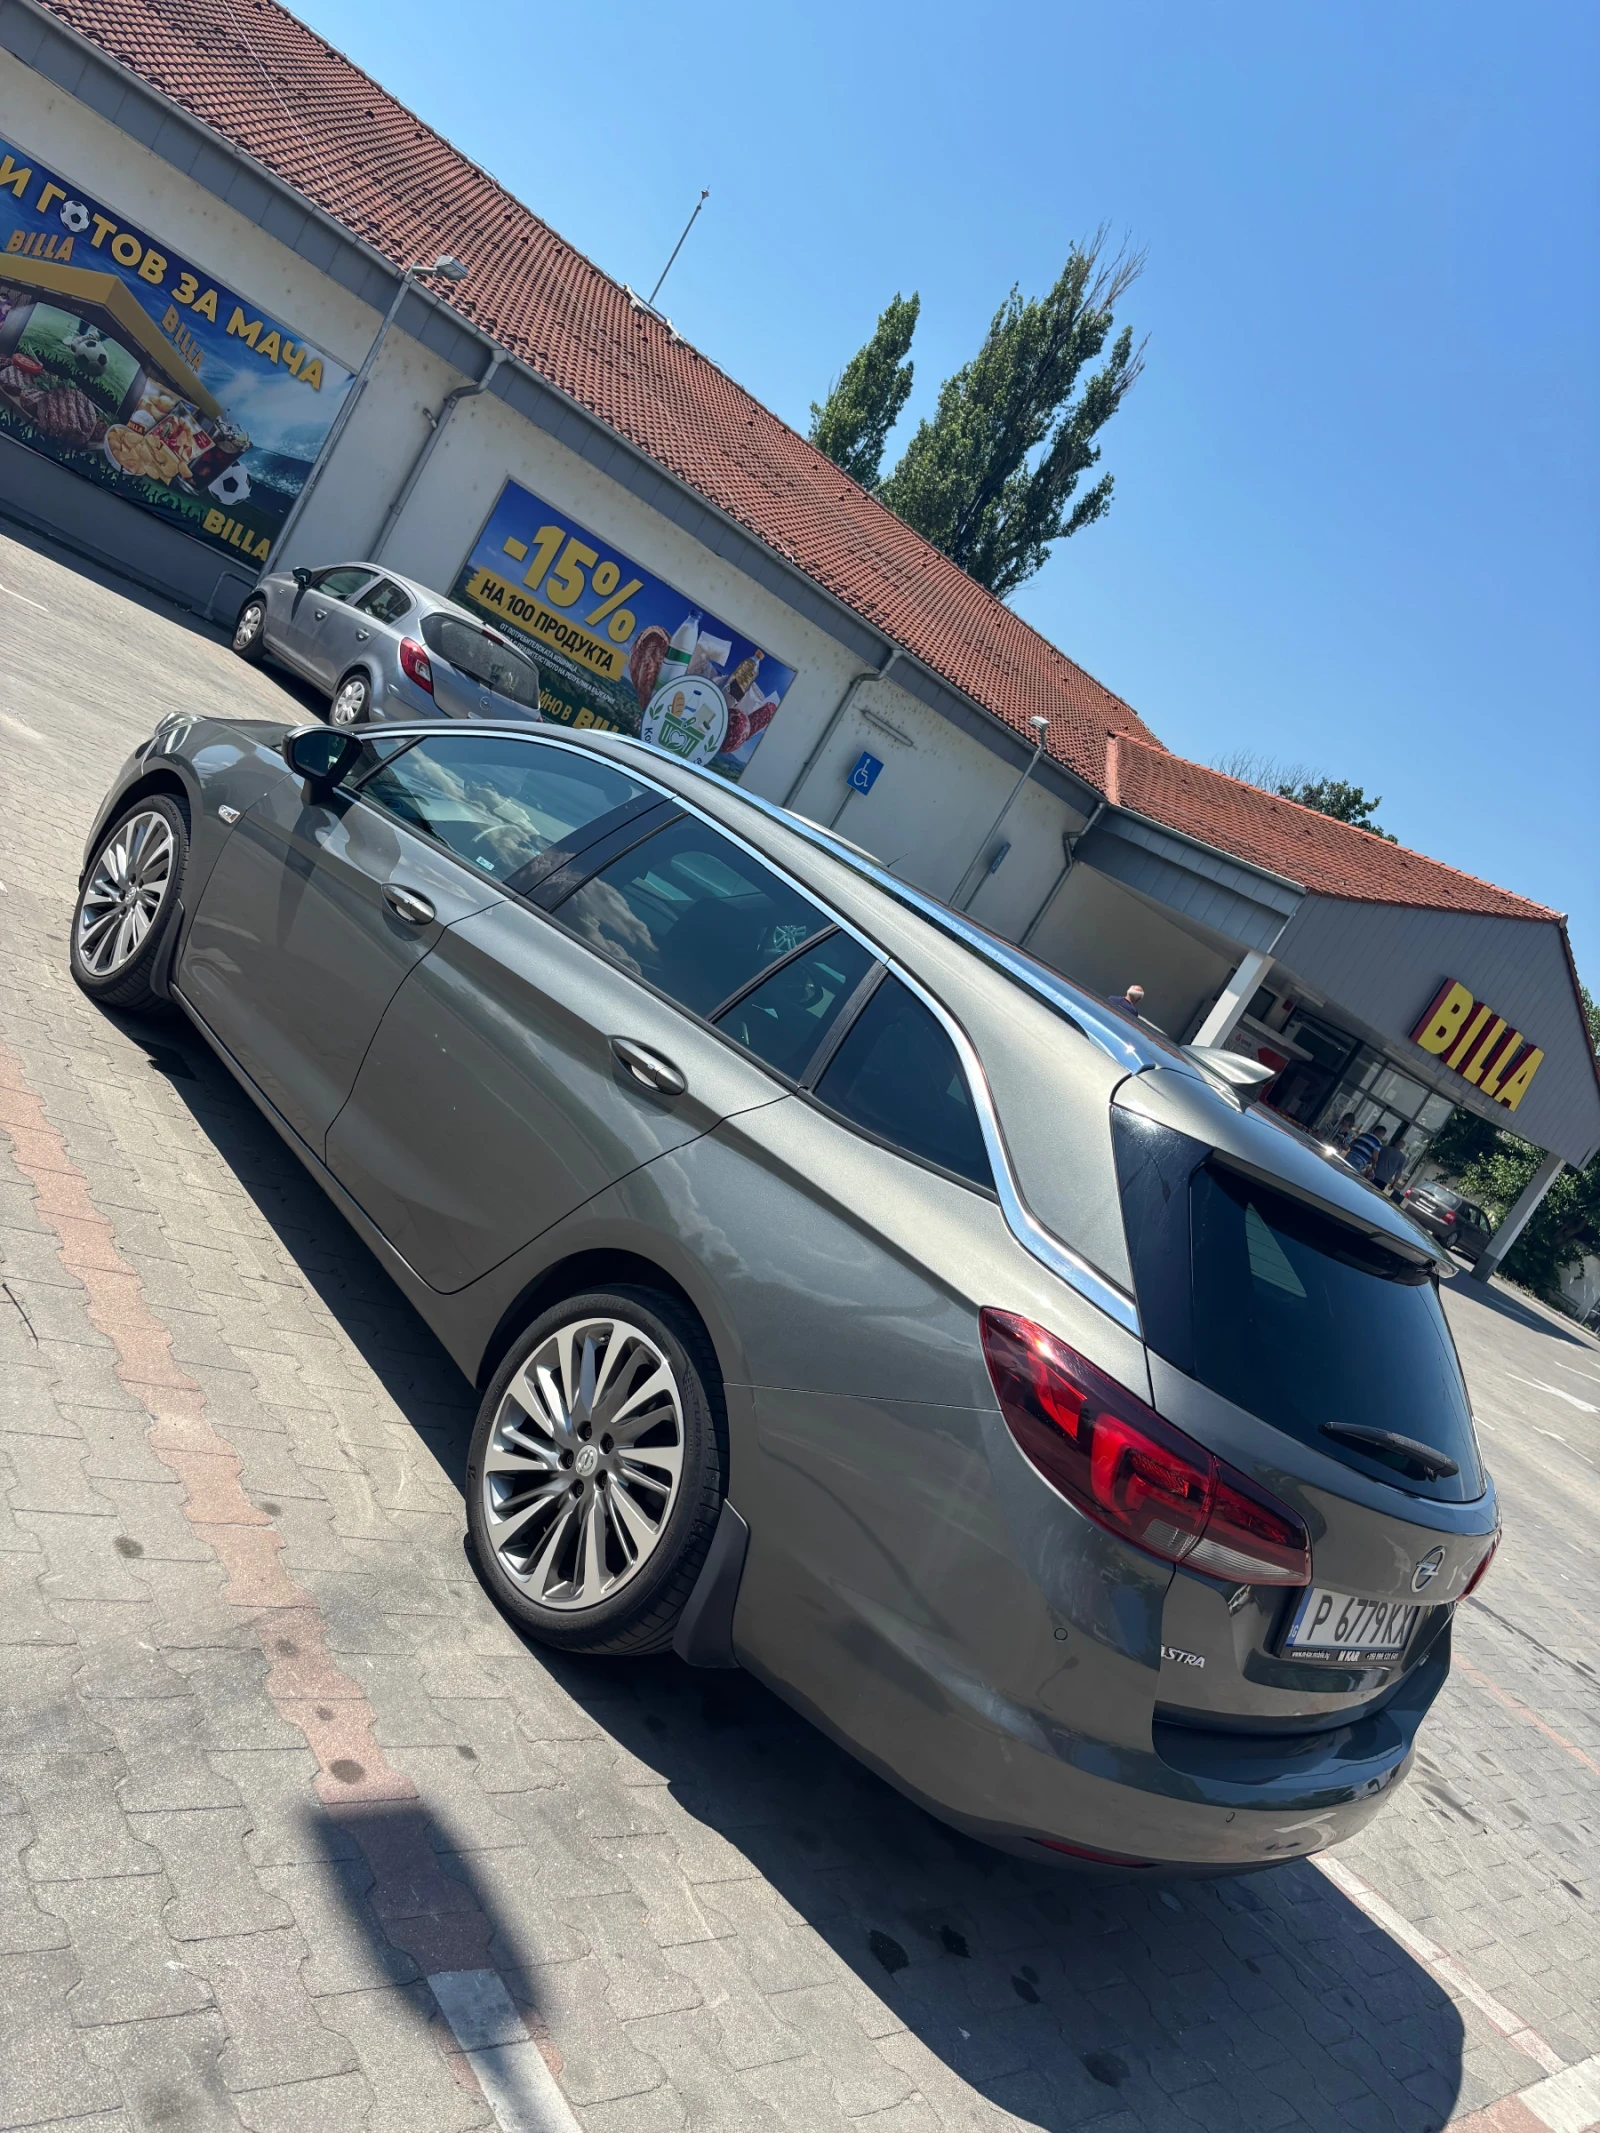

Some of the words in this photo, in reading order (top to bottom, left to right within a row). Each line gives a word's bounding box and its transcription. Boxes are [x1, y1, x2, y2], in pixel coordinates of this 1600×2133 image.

[5, 229, 75, 262] BILLA
[161, 303, 205, 373] BILLA
[171, 271, 218, 323] ЗА
[226, 306, 324, 390] МАЧА
[202, 508, 272, 562] BILLA
[502, 525, 644, 643] -15%
[479, 578, 505, 606] НА
[506, 593, 535, 622] 100
[533, 612, 614, 671] ПРОДУКТА
[499, 622, 510, 633] ОТ
[557, 667, 567, 677] НА
[538, 688, 563, 716] ЙНО
[560, 703, 573, 721] В
[1413, 978, 1544, 1112] BILLA
[1307, 1594, 1333, 1640] P
[1334, 1597, 1413, 1644] 6779KX
